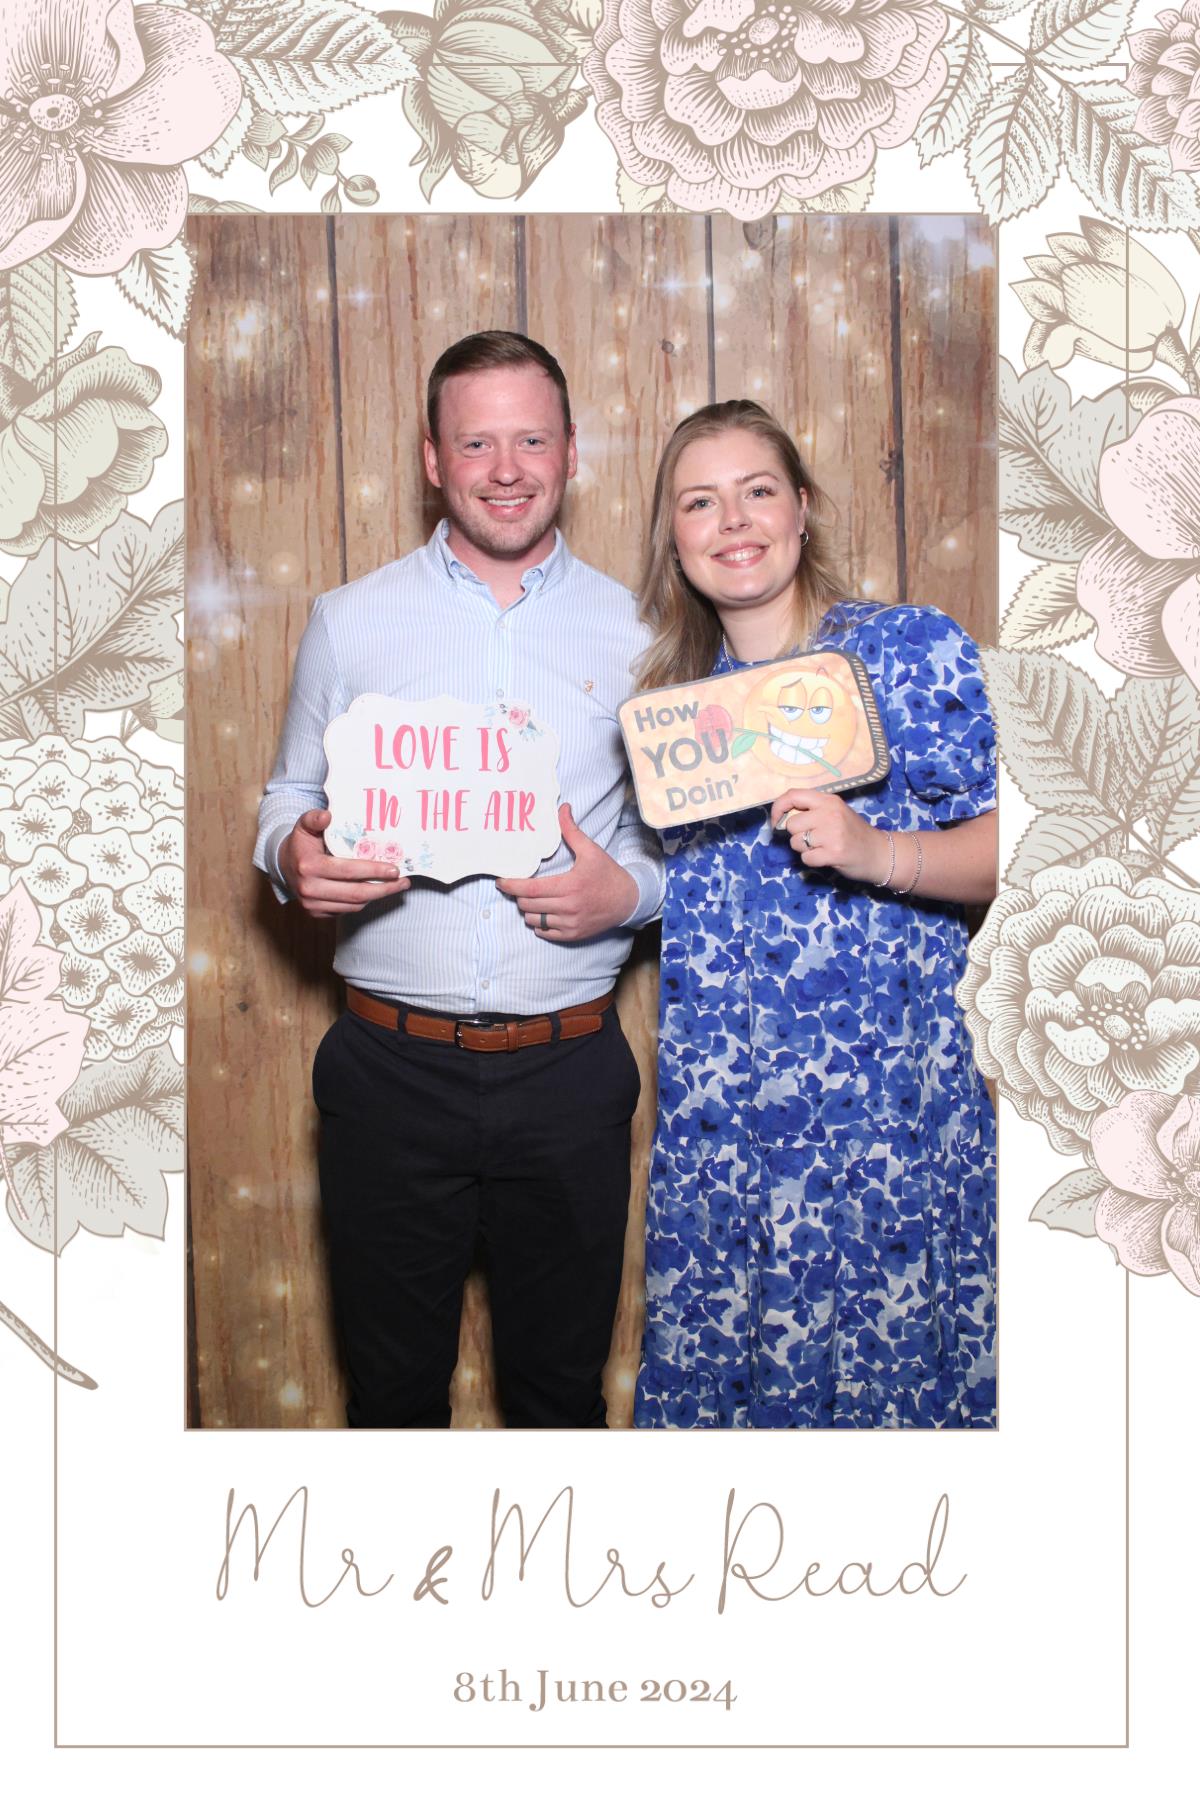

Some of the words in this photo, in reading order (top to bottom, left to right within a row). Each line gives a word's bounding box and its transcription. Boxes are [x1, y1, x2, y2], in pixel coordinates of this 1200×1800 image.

[633, 701, 699, 733] How
[374, 723, 461, 771] LOVE
[477, 727, 513, 773] IS
[641, 729, 729, 778] YOU
[416, 789, 471, 832] THE
[484, 790, 536, 832] AIR
